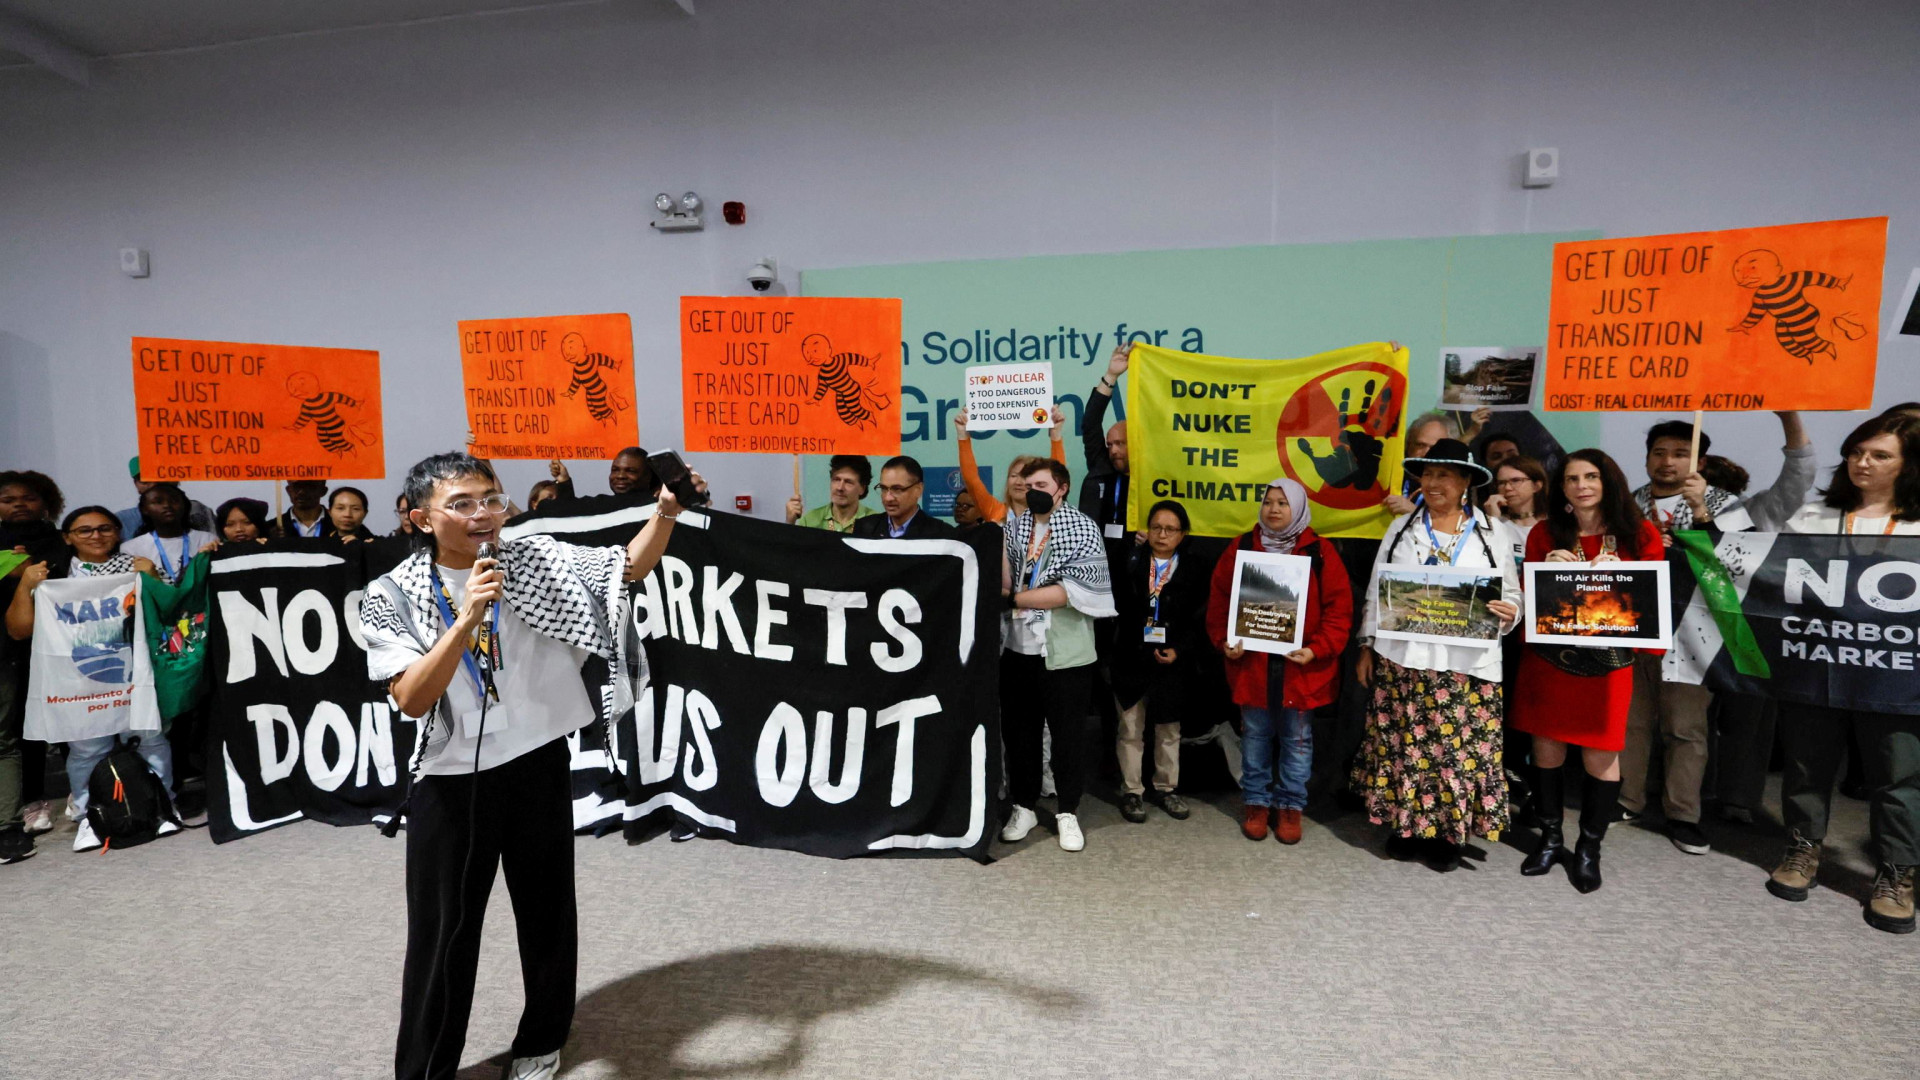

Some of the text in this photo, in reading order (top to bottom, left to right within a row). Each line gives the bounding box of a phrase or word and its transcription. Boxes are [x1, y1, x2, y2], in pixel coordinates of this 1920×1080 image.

[1565, 246, 1713, 281] GET OUT OF
[1592, 287, 1660, 315] JUST
[689, 310, 795, 334] GET OUT OF
[464, 330, 548, 354] GET OUT OF
[1556, 320, 1703, 348] TRANSITION
[719, 342, 770, 366] JUST
[922, 326, 1102, 366] Solidarity
[1180, 326, 1204, 353] a
[139, 347, 266, 376] GET OUT OF
[486, 359, 524, 382] JUST
[1563, 355, 1689, 380] FREE CARD
[693, 373, 809, 397] TRANSITION
[997, 372, 1045, 383] NUCLEAR
[1465, 384, 1484, 392] Stop
[167, 380, 220, 403] JUST
[468, 387, 556, 408] TRANSITION
[977, 387, 1046, 397] TOO DANGEROUS
[1594, 393, 1628, 408] REAL
[1632, 394, 1692, 408] CLIMATE
[1701, 393, 1764, 408] ACTION
[694, 402, 800, 425] FREE CARD
[996, 400, 1039, 408] EXPENSIVE
[142, 407, 265, 430] TRANSITION
[475, 413, 550, 435] FREE CARD
[979, 413, 996, 421] TOO
[1172, 413, 1251, 433] NUKE
[155, 434, 260, 455] FREE CARD
[491, 444, 533, 457] INDIGENOUS
[535, 446, 574, 458] PEOPLE'S
[575, 446, 606, 459] RIGHTS
[750, 436, 836, 452] BIODIVERSITY
[1182, 447, 1238, 467] THE
[205, 464, 240, 478] FOOD
[246, 464, 333, 477] SOVEREIGNITY
[1555, 574, 1633, 582] Hot Air Kills the
[1576, 584, 1611, 592] Planet!
[1784, 558, 1920, 613] NO
[54, 596, 121, 625] MAR
[1243, 607, 1290, 619] Stop Destroying
[1254, 615, 1278, 624] Forests
[217, 587, 339, 684] NO
[1249, 629, 1280, 639] Bioenergy
[1257, 622, 1285, 631] Industrial
[1553, 622, 1639, 632] No False Solutions!
[1781, 615, 1920, 645] CARBO
[1783, 639, 1920, 670] MARKE
[46, 688, 123, 704] Movimiento
[87, 702, 110, 713] por
[634, 684, 723, 791] US
[755, 694, 943, 808] OUT
